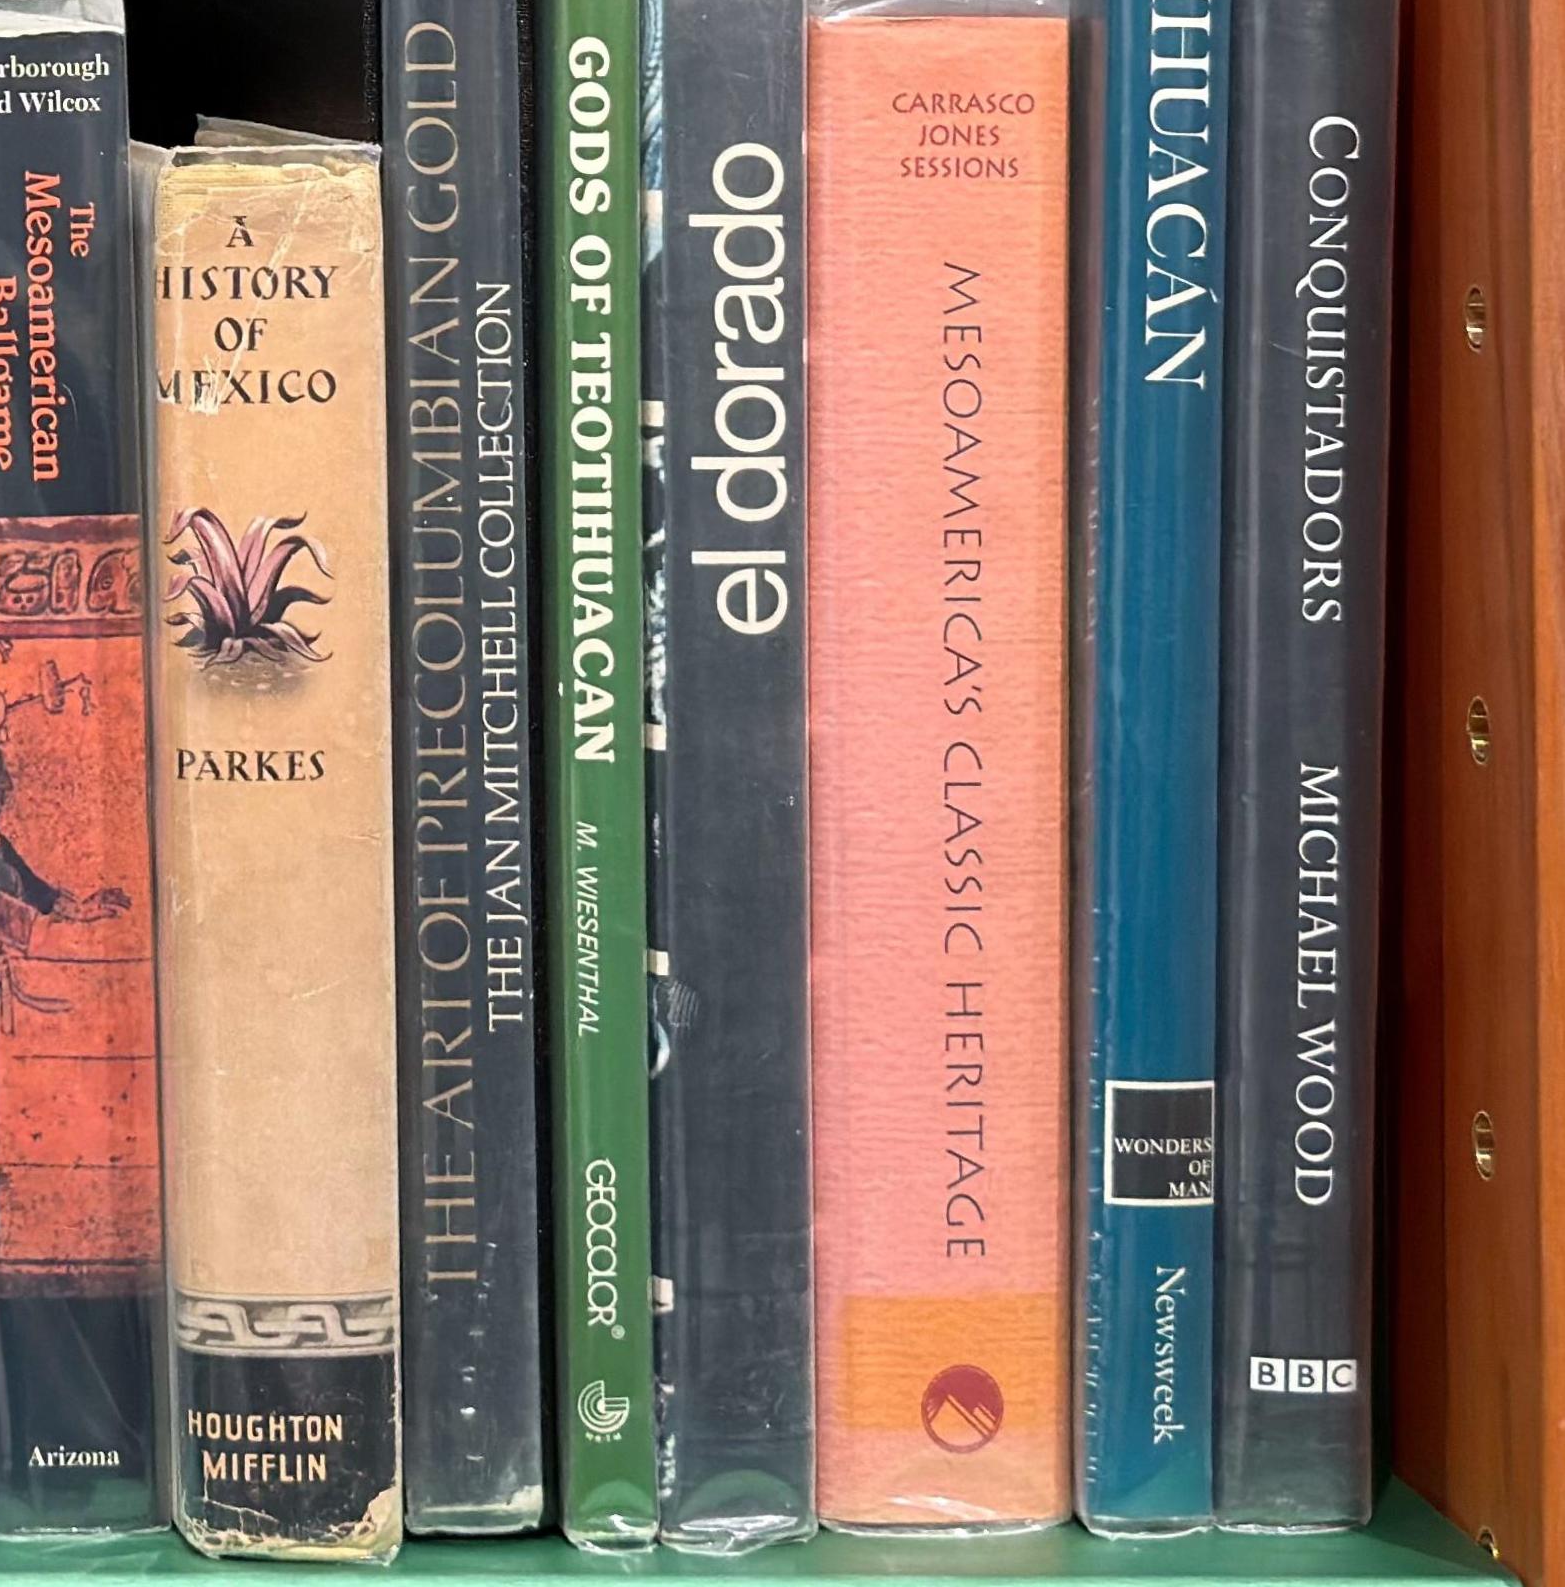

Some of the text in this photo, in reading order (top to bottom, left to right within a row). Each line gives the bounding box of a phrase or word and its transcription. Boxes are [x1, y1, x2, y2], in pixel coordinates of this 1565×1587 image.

[18, 89, 102, 114] Wilcox
[891, 91, 1036, 117] CARRASCO
[918, 124, 1000, 149] JONES
[900, 156, 1020, 180] SESSIONS
[69, 201, 95, 259] The
[156, 264, 339, 301] HISTORY
[23, 169, 66, 482] Mesoamerican
[213, 316, 269, 353] OF
[1296, 115, 1361, 624] CONQUISTADORS
[568, 35, 616, 765] GODS OF TEOTIHUACAN
[688, 141, 789, 636] el dorado
[404, 20, 478, 1285] THE ART OF PRECOLUMBIAN GOLD
[475, 280, 528, 1033] THE JAN MITCHELL COLLECTION
[176, 748, 325, 784] PARKES
[942, 261, 987, 1259] MESOAMERICA'S CLASSIC HERITAGE
[1293, 760, 1340, 1208] MICHAEL WOOD
[1113, 1135, 1213, 1156] WONDERS
[1188, 1158, 1212, 1177] OF
[1168, 1180, 1212, 1198] MAN
[1152, 1264, 1188, 1446] Newsweek
[186, 1409, 344, 1443] HOUGHTON
[27, 1445, 121, 1469] Arizona
[202, 1451, 327, 1484] MIFFLIN
